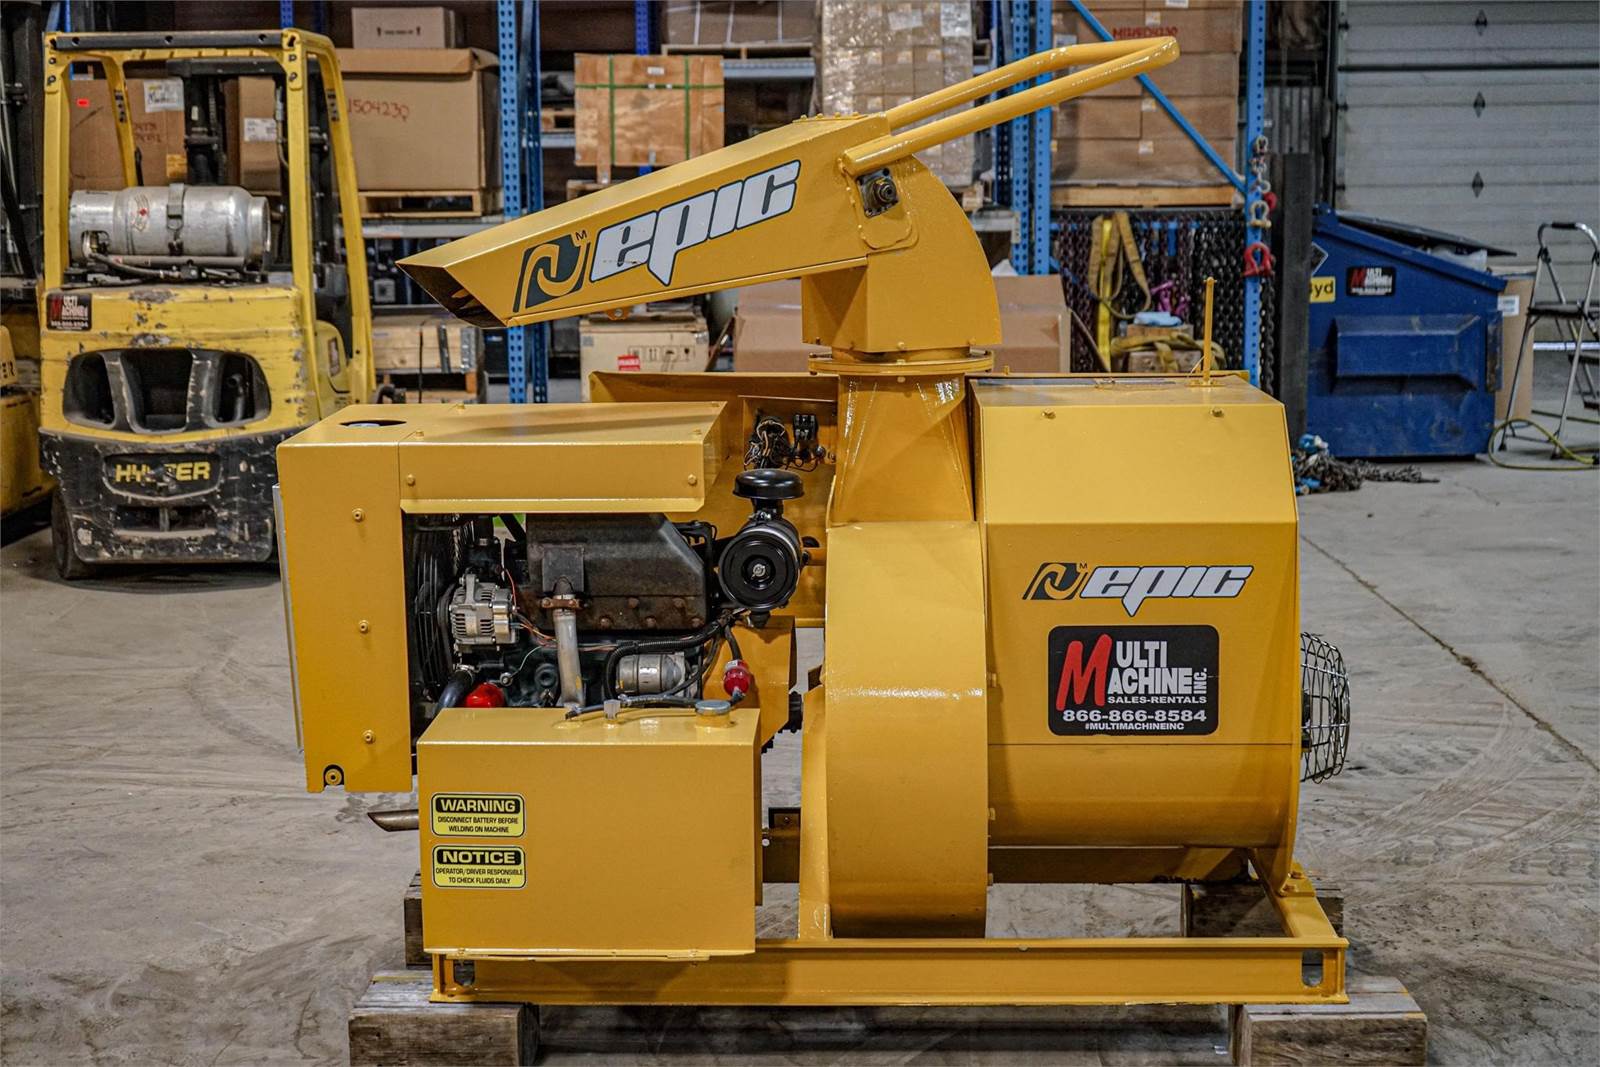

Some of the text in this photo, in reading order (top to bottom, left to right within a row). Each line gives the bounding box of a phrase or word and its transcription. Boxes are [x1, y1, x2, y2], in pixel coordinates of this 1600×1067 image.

[589, 160, 801, 286] epic
[1080, 566, 1254, 617] epic
[1108, 696, 1207, 704] SALES-RENTALS
[1063, 709, 1207, 722] 866-866-8584
[1085, 722, 1185, 730] #MULTIMACHINEINC
[441, 799, 516, 812] WARNING
[438, 816, 472, 824] DISCONNECT
[442, 851, 516, 864] NOTICE
